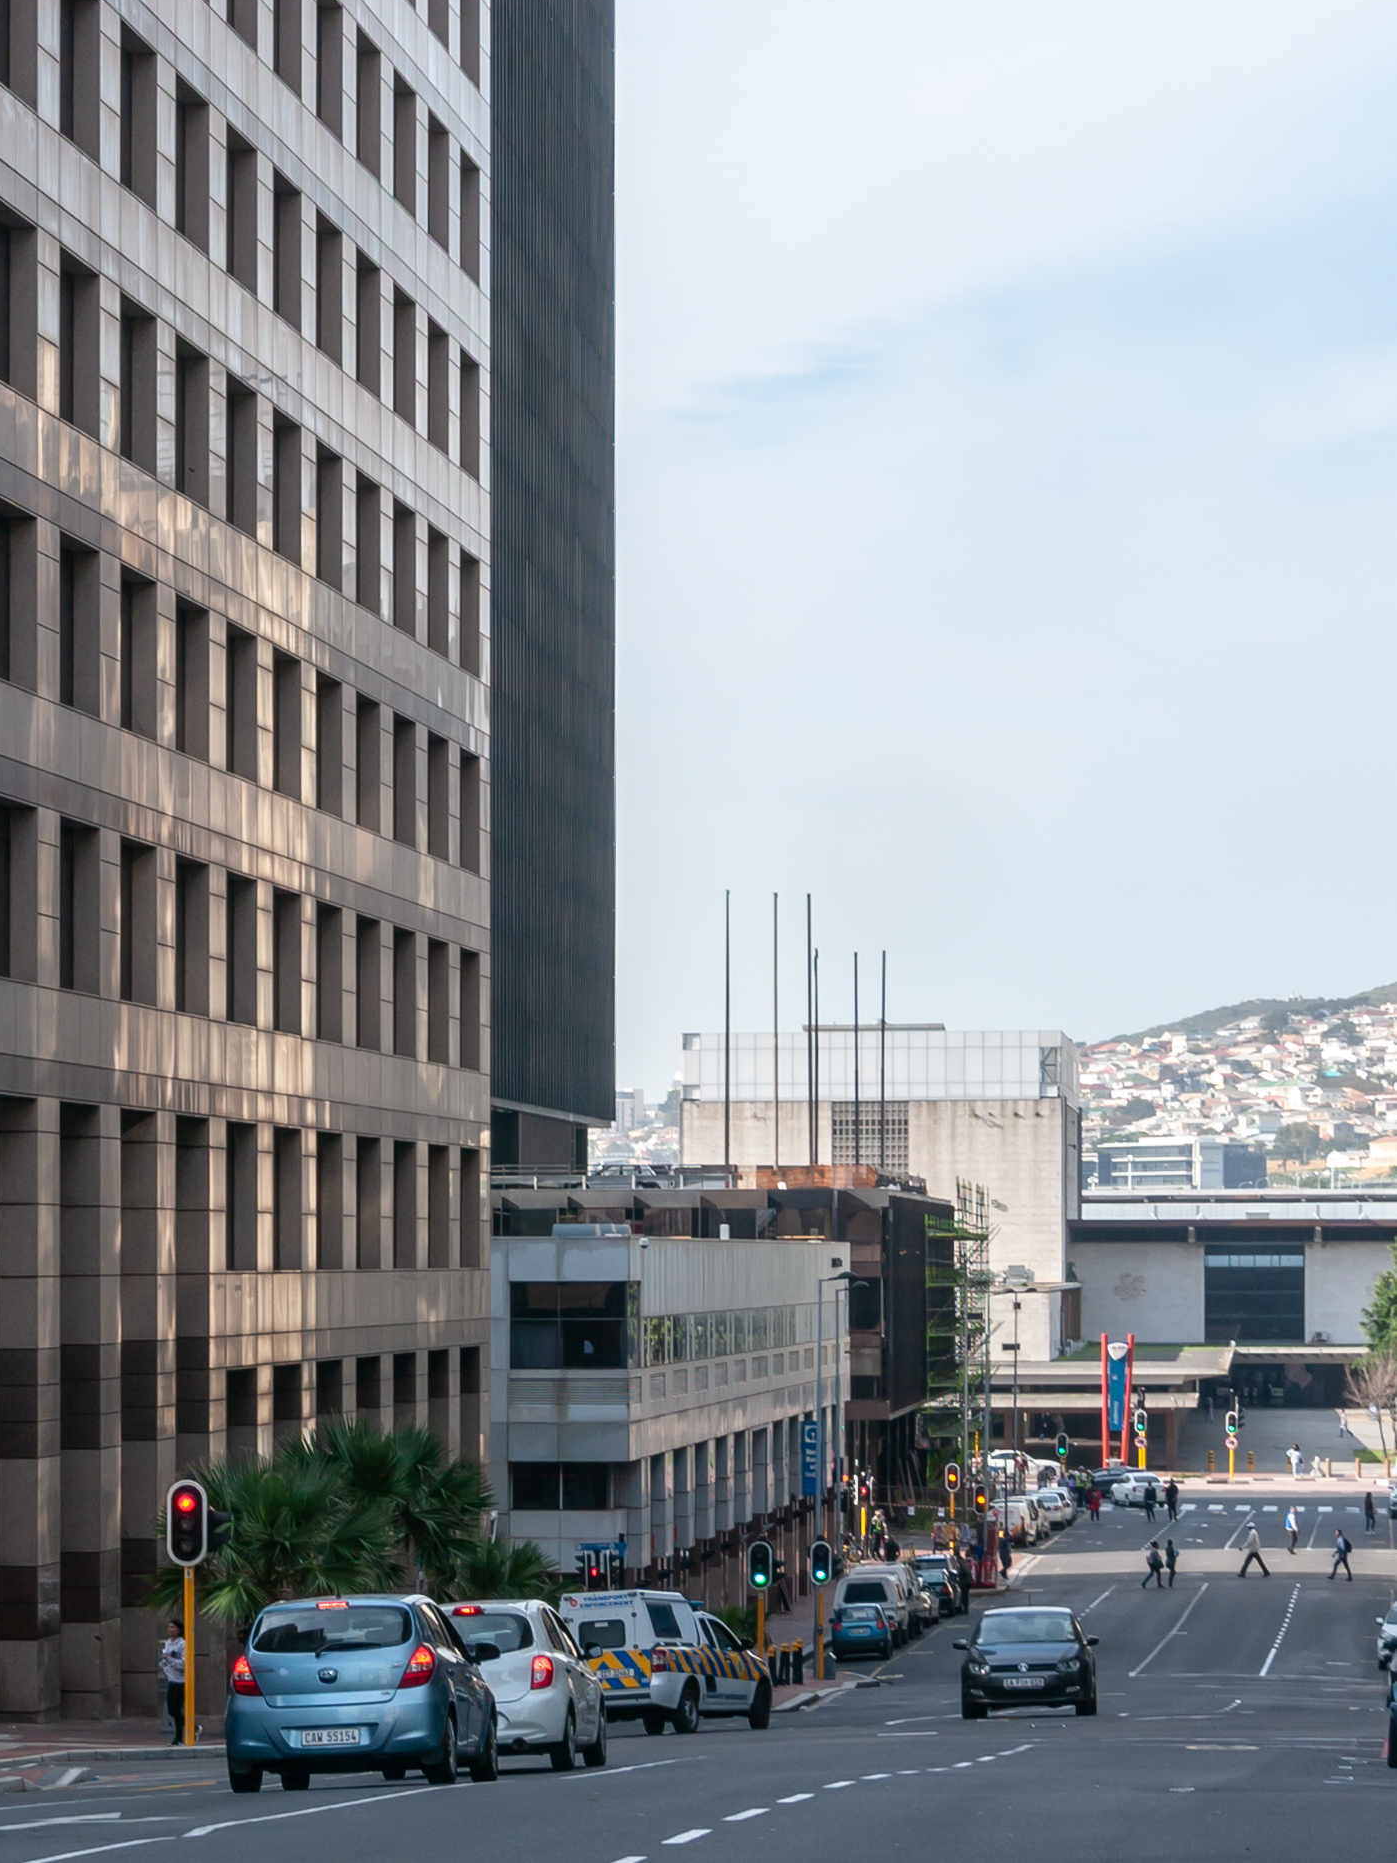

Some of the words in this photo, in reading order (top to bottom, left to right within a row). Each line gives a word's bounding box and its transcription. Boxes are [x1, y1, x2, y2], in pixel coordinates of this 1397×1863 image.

[583, 1594, 628, 1602] TRANSPORT
[579, 1600, 634, 1609] ENFORCEMENT
[304, 1732, 324, 1744] CAW
[327, 1730, 357, 1743] 55154
